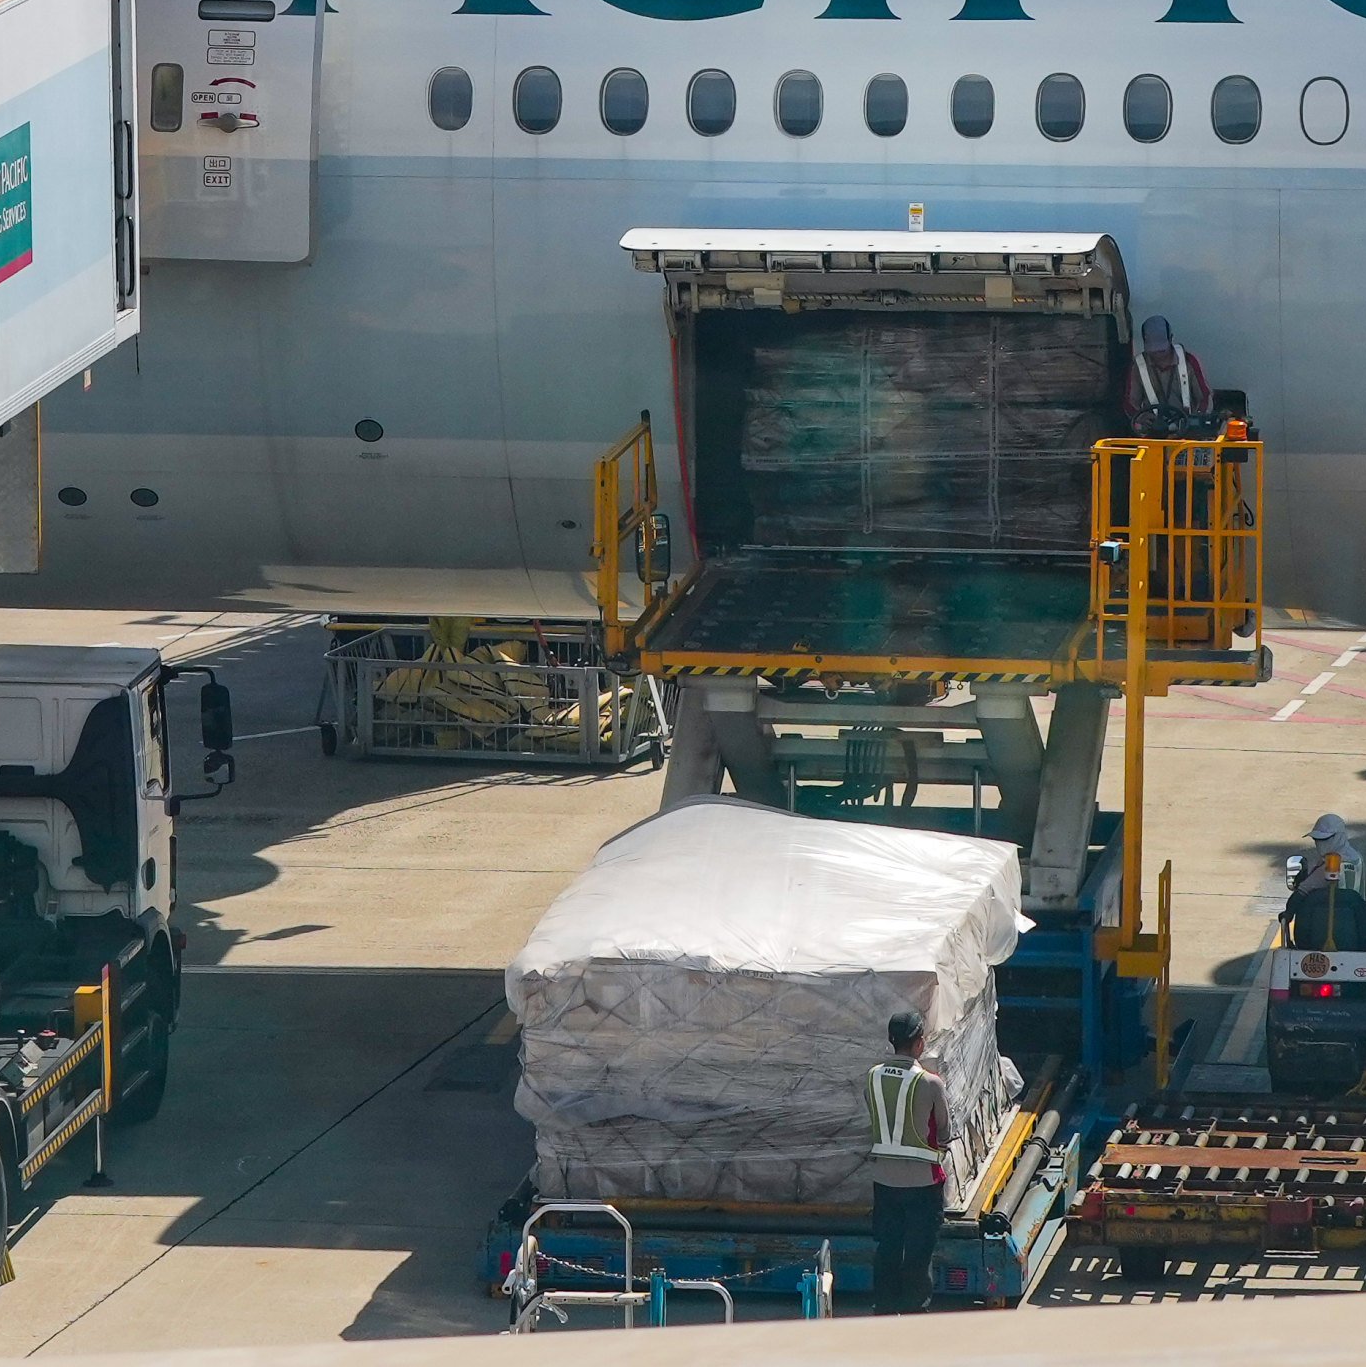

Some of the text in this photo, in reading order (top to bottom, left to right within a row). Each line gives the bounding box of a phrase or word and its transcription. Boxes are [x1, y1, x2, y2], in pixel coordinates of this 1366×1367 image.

[192, 94, 214, 102] OPEN
[209, 158, 226, 168] 出口
[1, 155, 29, 195] PACIFIC
[205, 175, 229, 184] EXIT
[2, 201, 27, 232] SERVICES
[884, 1068, 903, 1076] HAS
